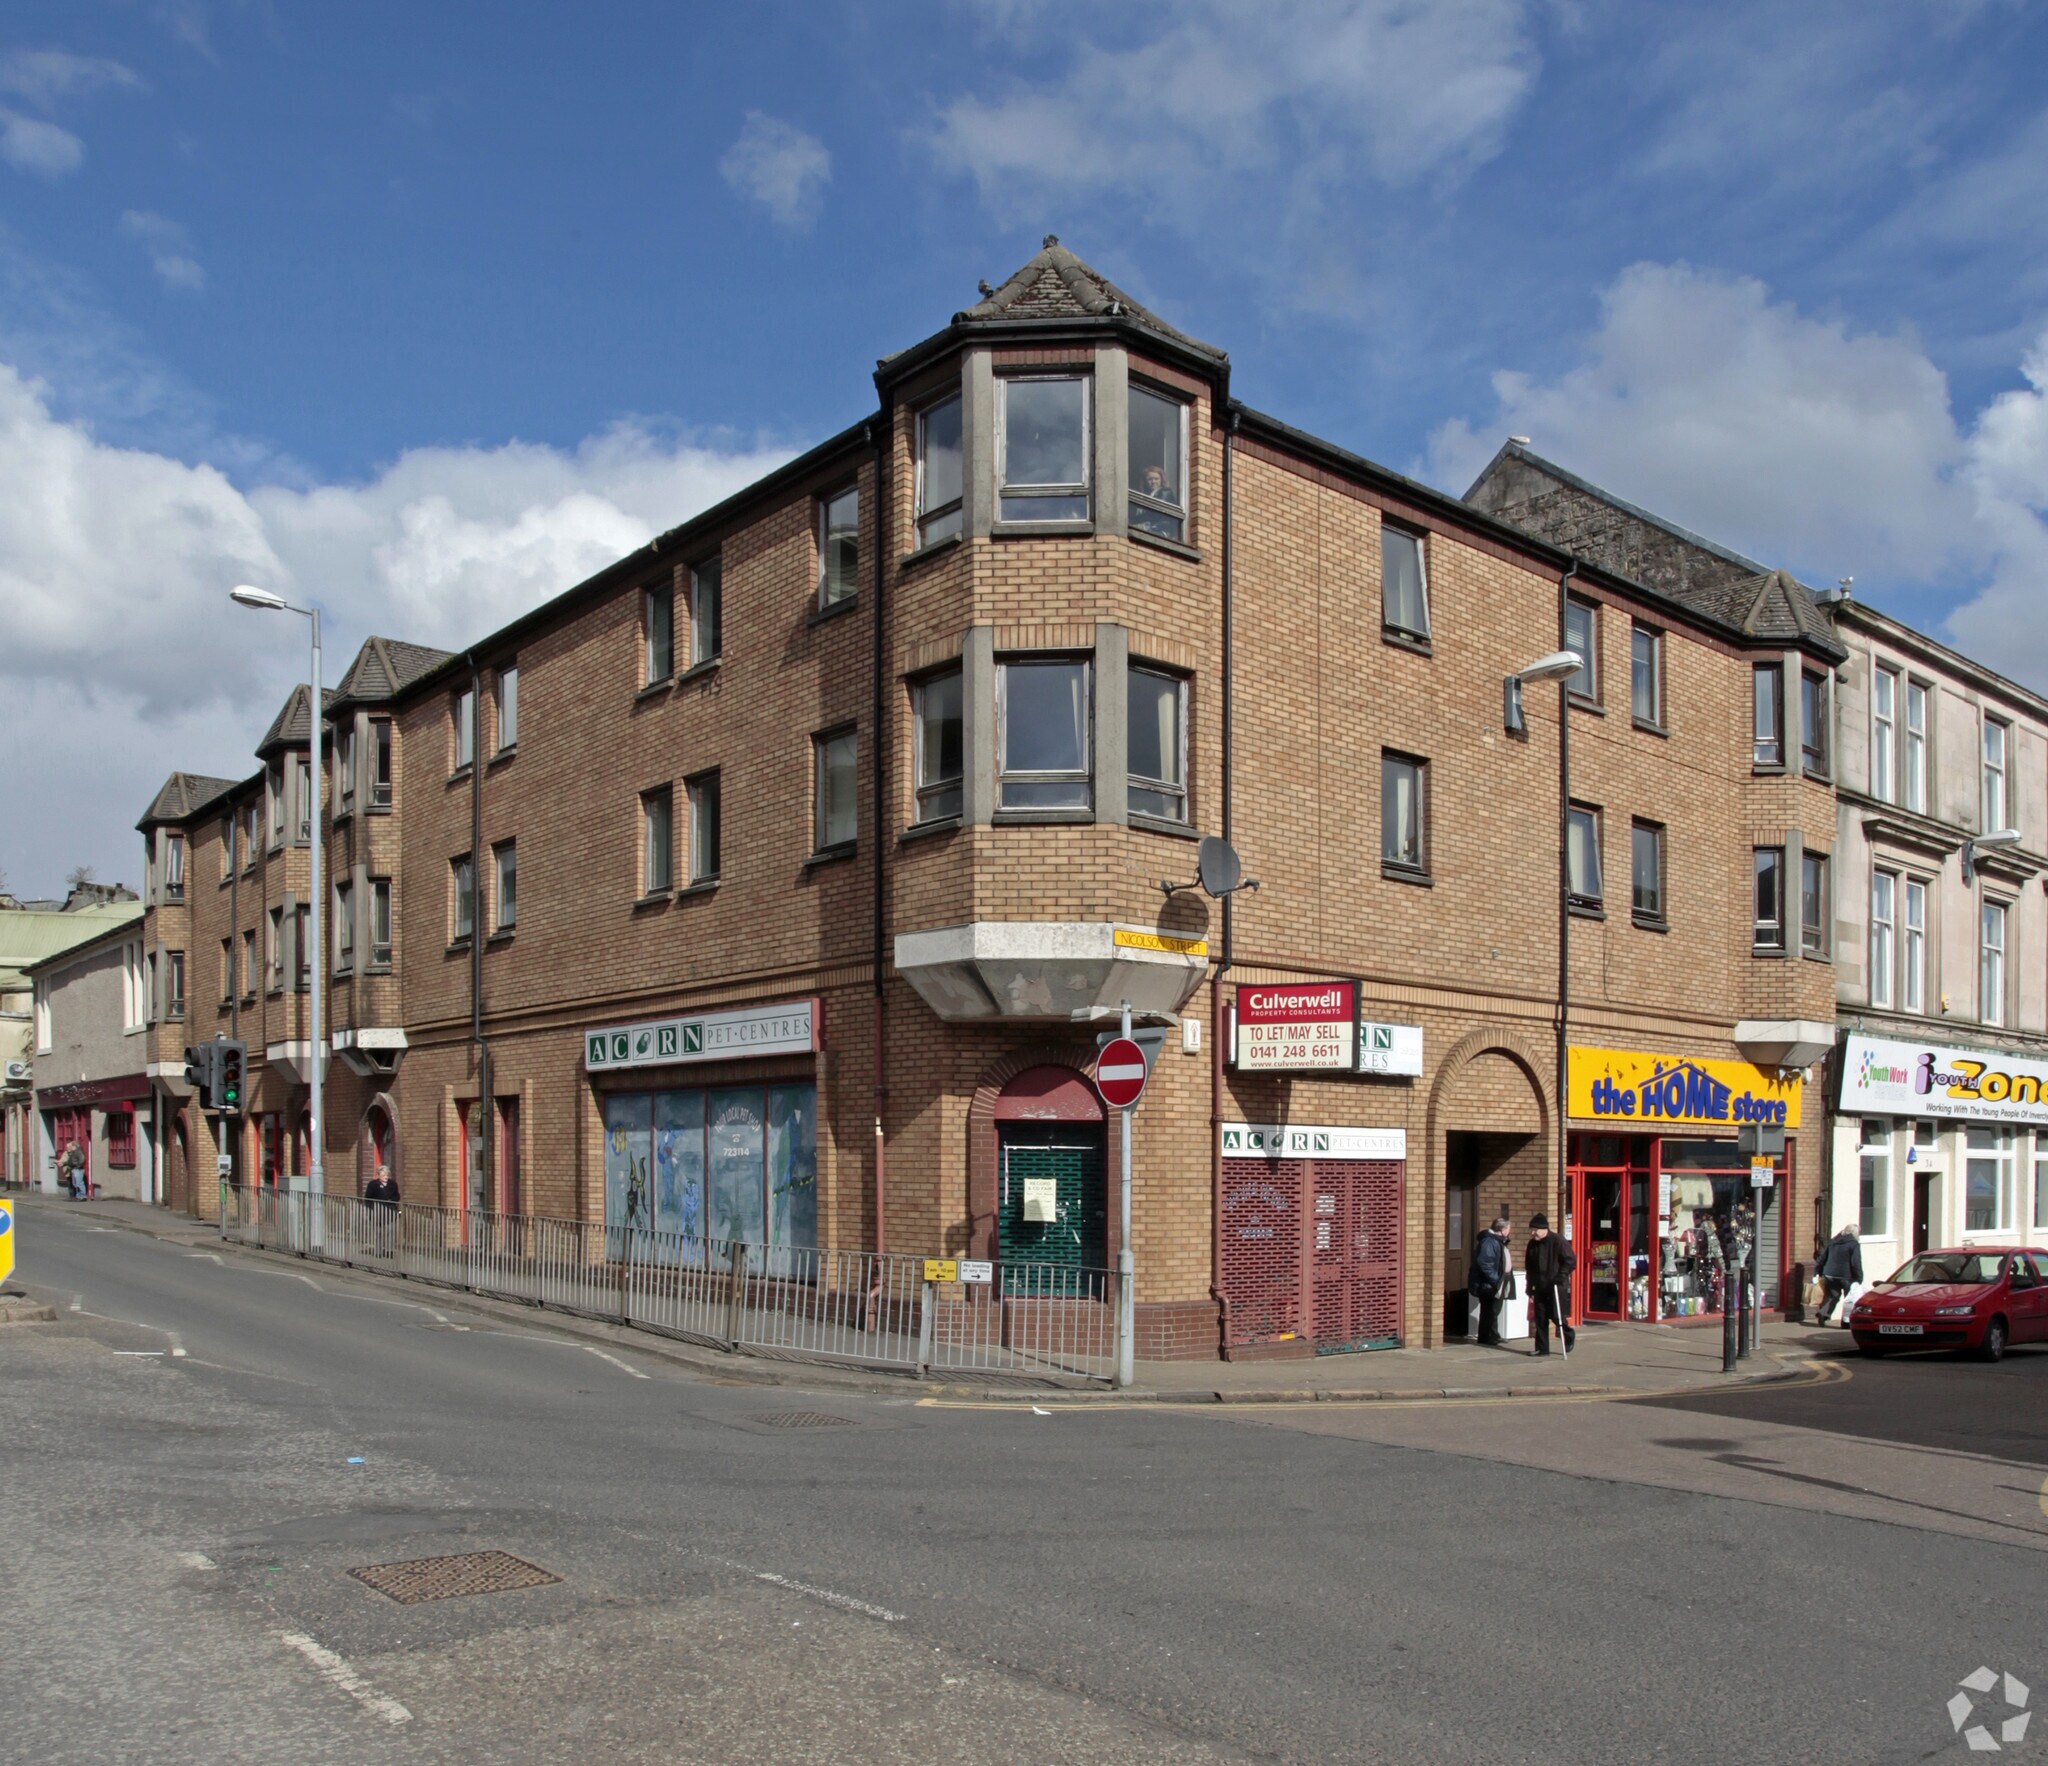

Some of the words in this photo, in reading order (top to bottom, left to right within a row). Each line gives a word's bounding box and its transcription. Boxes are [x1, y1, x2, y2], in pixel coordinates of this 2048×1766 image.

[1121, 933, 1165, 949] NICOLSON
[1170, 939, 1202, 953] STREET
[1249, 990, 1341, 1009] Culverwell
[1250, 1009, 1287, 1017] PROPERTY
[1288, 1008, 1341, 1016] CONSULTANTS
[1250, 1027, 1264, 1041] TO
[1316, 1025, 1340, 1039] SELL
[1250, 1046, 1277, 1059] 0141
[1283, 1045, 1306, 1058] 248
[1312, 1044, 1340, 1057] 6611
[1250, 1059, 1339, 1067] www.culverwell.co.uk
[1929, 1073, 1979, 1088] YOUTH
[1591, 1076, 1636, 1115] the
[1641, 1066, 1729, 1119] HOME
[1733, 1091, 1787, 1122] store
[1926, 1103, 1952, 1115] Working
[1954, 1105, 1968, 1114] With
[1969, 1106, 1980, 1115] The
[1981, 1107, 1999, 1118] Young
[2000, 1108, 2019, 1120] People
[2021, 1109, 2029, 1118] Of
[723, 1147, 750, 1157] 723114
